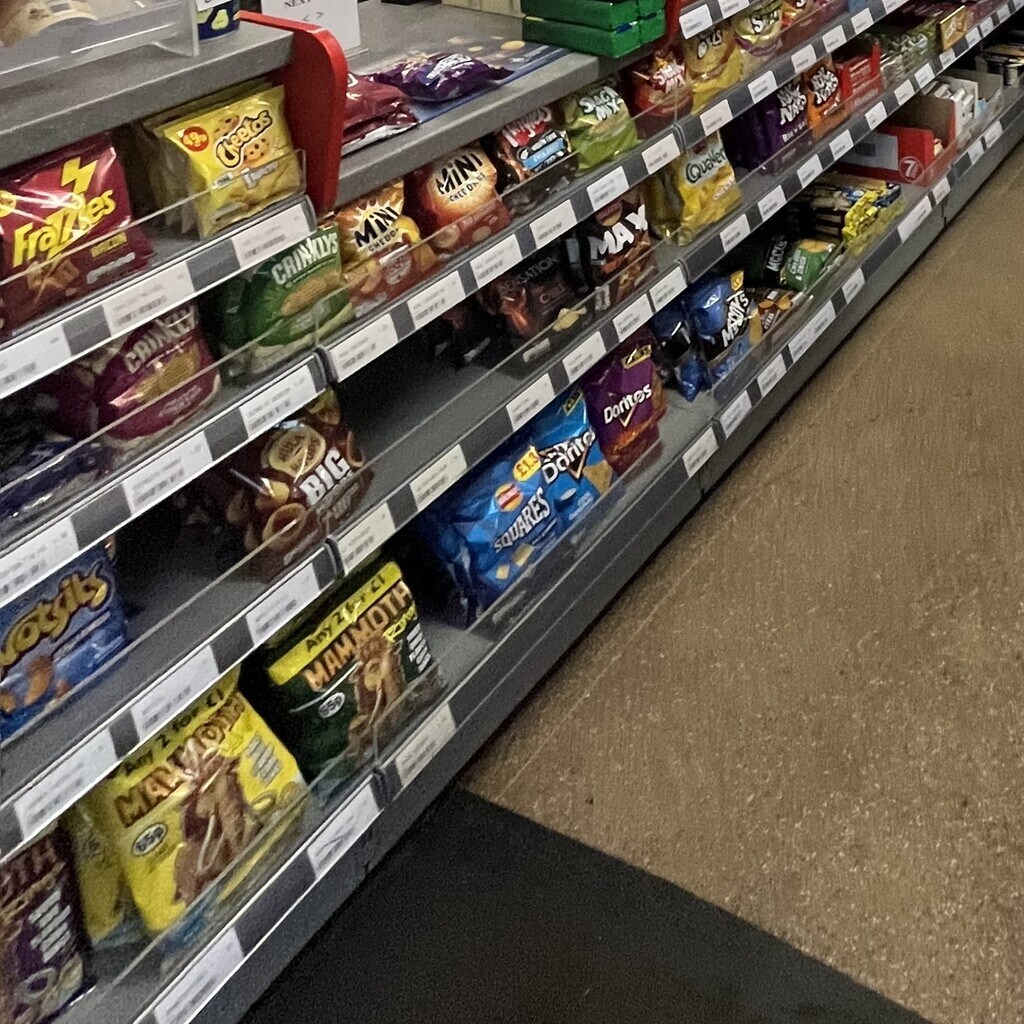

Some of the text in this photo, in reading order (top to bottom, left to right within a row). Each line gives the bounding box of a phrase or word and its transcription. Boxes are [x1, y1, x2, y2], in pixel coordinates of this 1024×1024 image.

[215, 109, 274, 169] Cheetos
[436, 152, 483, 195] MINI
[685, 147, 726, 184] Quaver
[354, 204, 400, 248] MINI
[368, 226, 400, 253] CHEDD
[589, 203, 649, 260] MAX
[603, 382, 653, 426] Doritos
[299, 448, 351, 506] BIG
[515, 450, 540, 478] £1.3
[540, 429, 597, 485] Dorito
[493, 487, 552, 553] SQUARES
